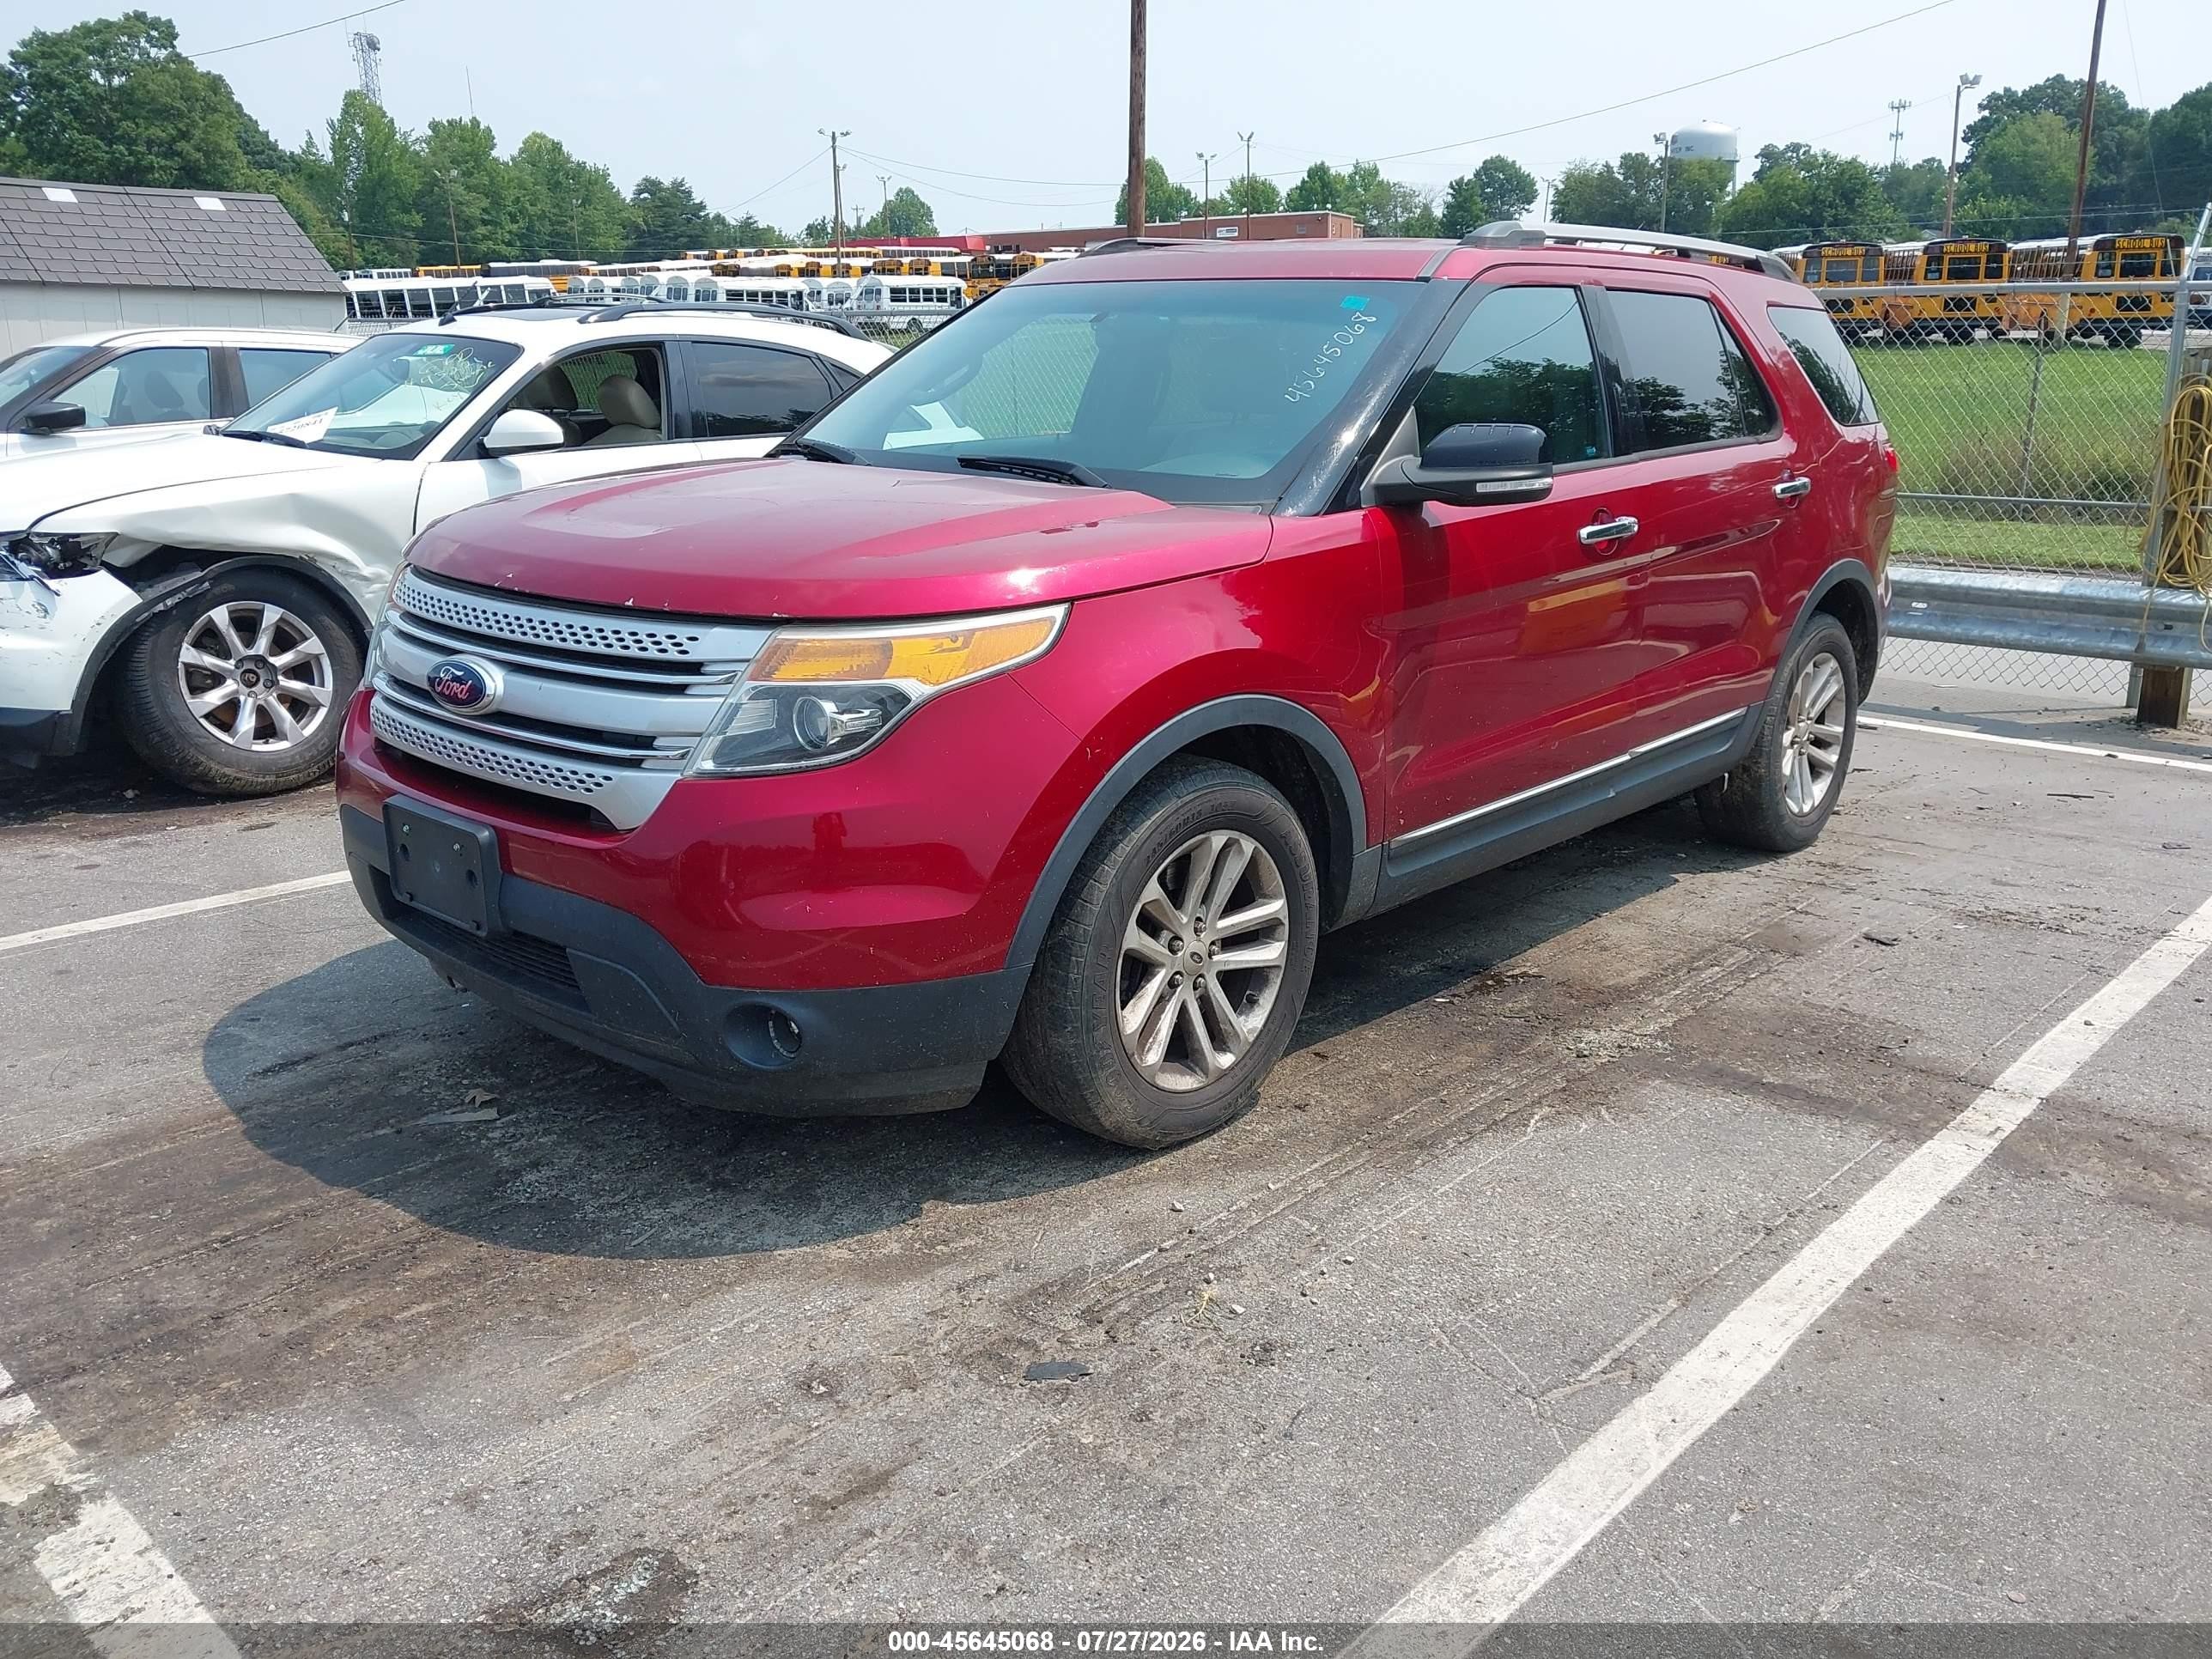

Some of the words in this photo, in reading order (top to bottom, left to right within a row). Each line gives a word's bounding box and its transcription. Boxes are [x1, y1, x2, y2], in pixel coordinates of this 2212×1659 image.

[1944, 243, 1972, 252] SCHOOL
[1975, 242, 1989, 252] BUS
[2118, 239, 2145, 249] SCHOOL
[2149, 238, 2164, 248] BUS
[1822, 247, 1849, 256] SCHOOL
[1851, 246, 1865, 255] BUS
[1285, 312, 1376, 402] 45645068
[434, 665, 472, 700] Ford
